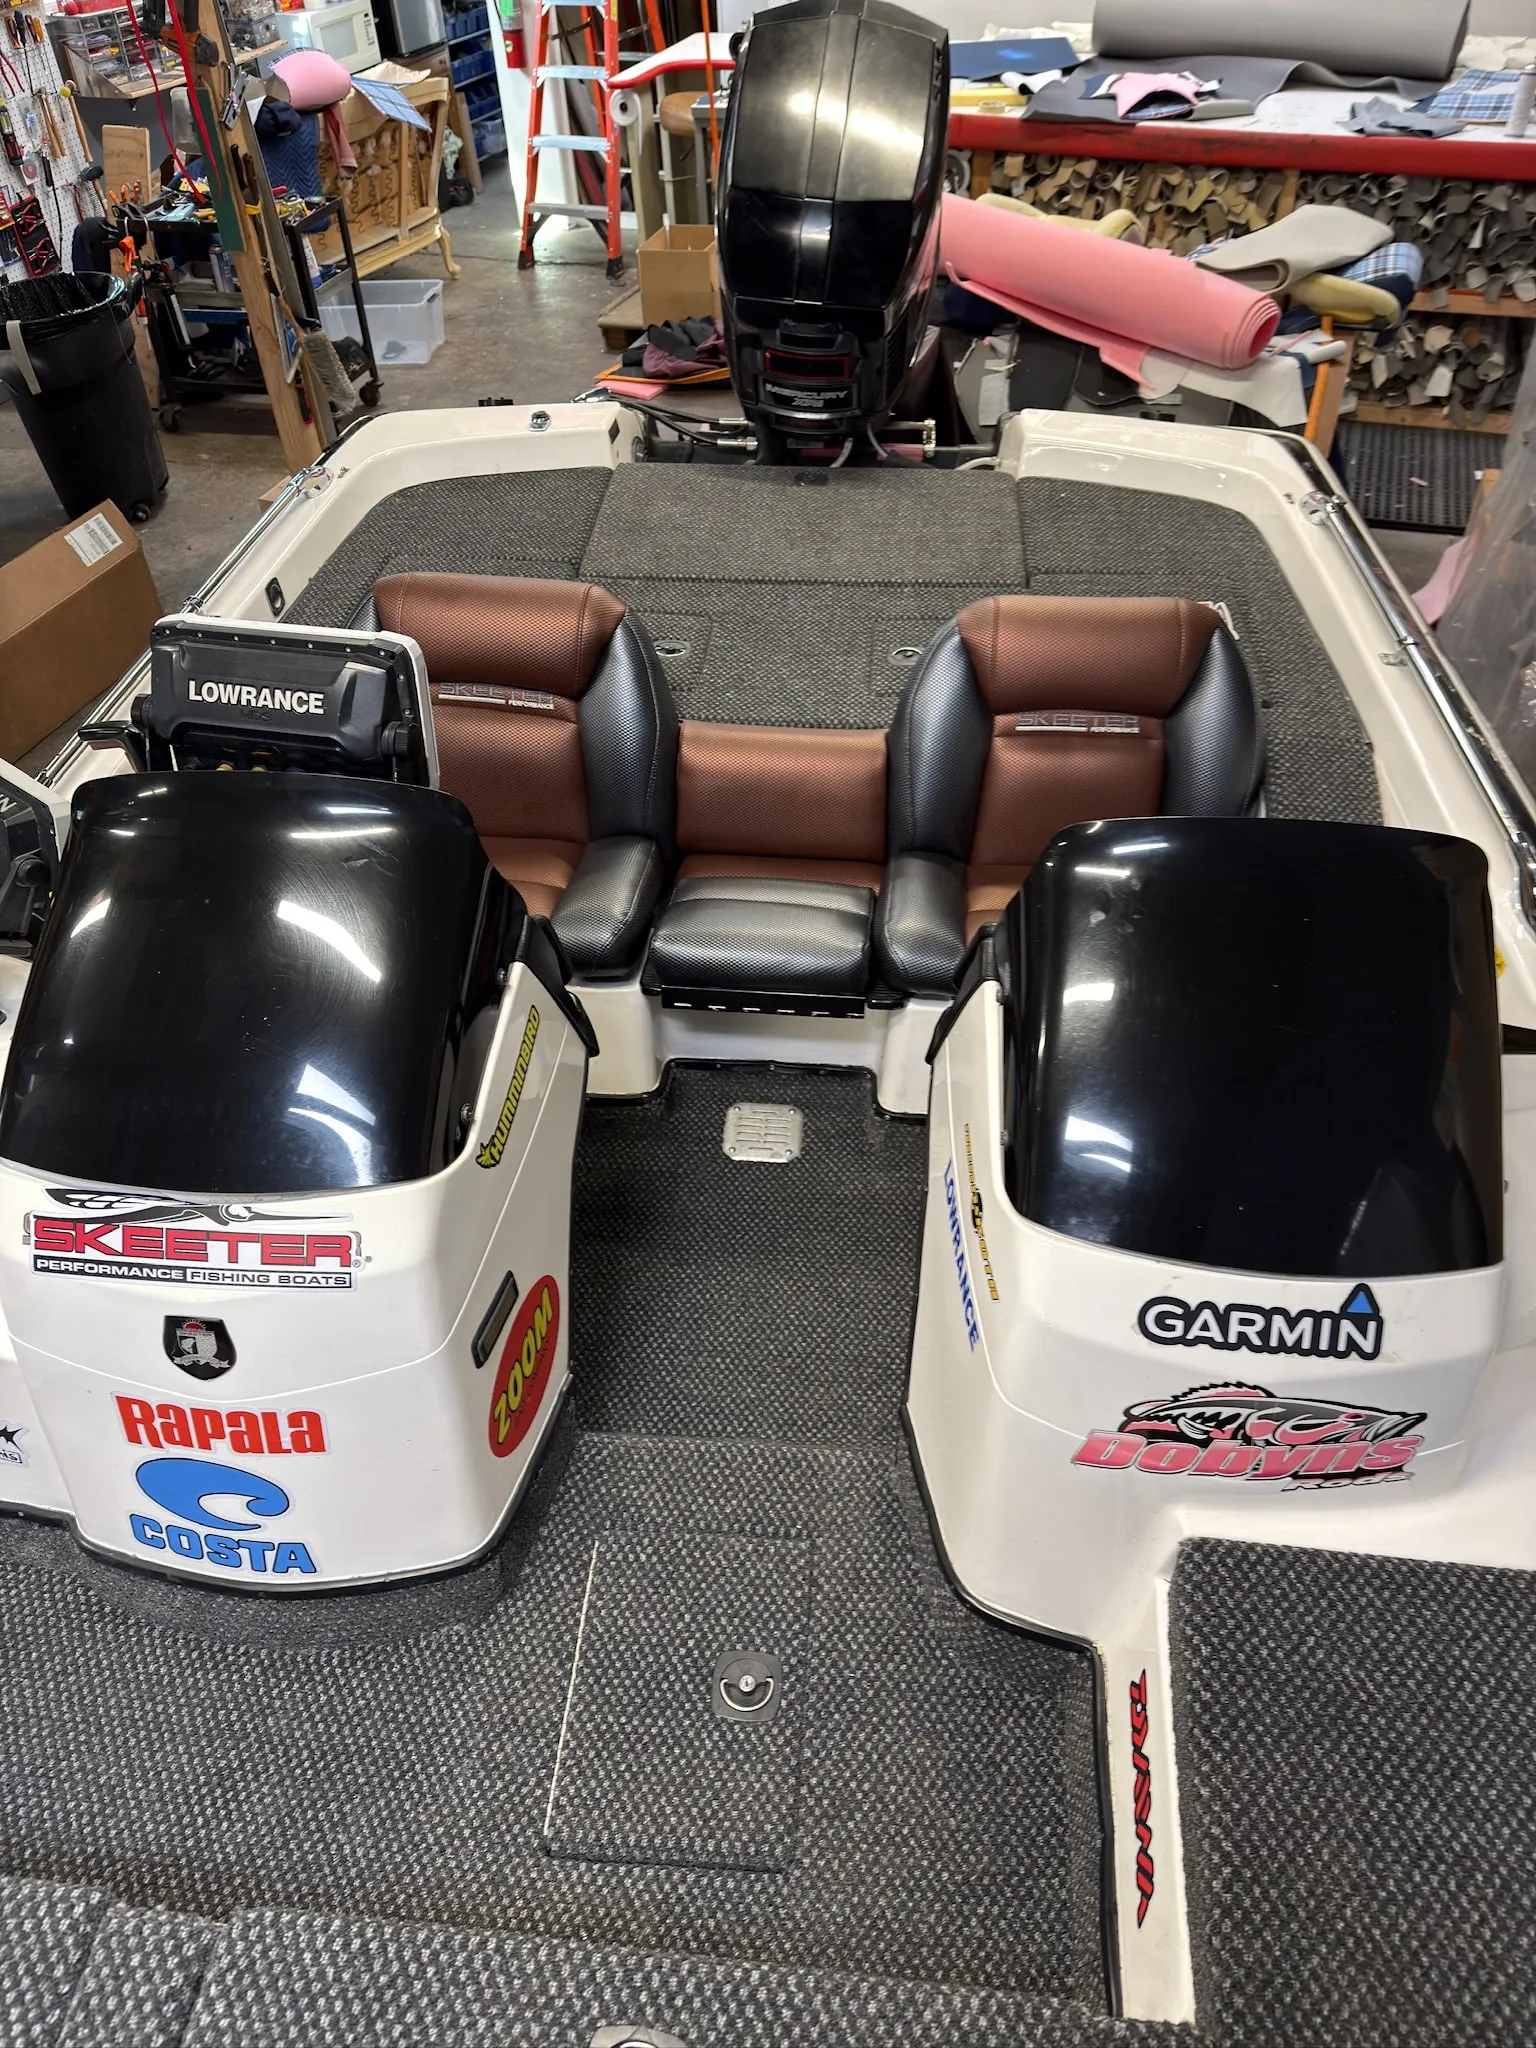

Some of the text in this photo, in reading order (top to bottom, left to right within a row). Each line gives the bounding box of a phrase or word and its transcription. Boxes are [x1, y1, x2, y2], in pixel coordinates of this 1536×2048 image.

[765, 383, 848, 400] MERCURY
[188, 679, 325, 715] LOWRANCE
[439, 682, 554, 703] SKEETER
[508, 700, 554, 710] PERFORMANCE
[1018, 713, 1140, 728] SKEETER
[486, 1005, 541, 1164] HUMMINBIRD
[32, 1217, 353, 1268] SKEETER
[943, 1158, 980, 1353] LOWRANCE
[36, 1259, 348, 1287] PERFORMANCE FISHING BOATS
[1144, 1303, 1378, 1355] GARMIN
[493, 1286, 554, 1445] ZOOM
[1071, 1429, 1424, 1480] Dobyns
[1281, 1469, 1415, 1492] Rods
[130, 1514, 317, 1574] COSTA
